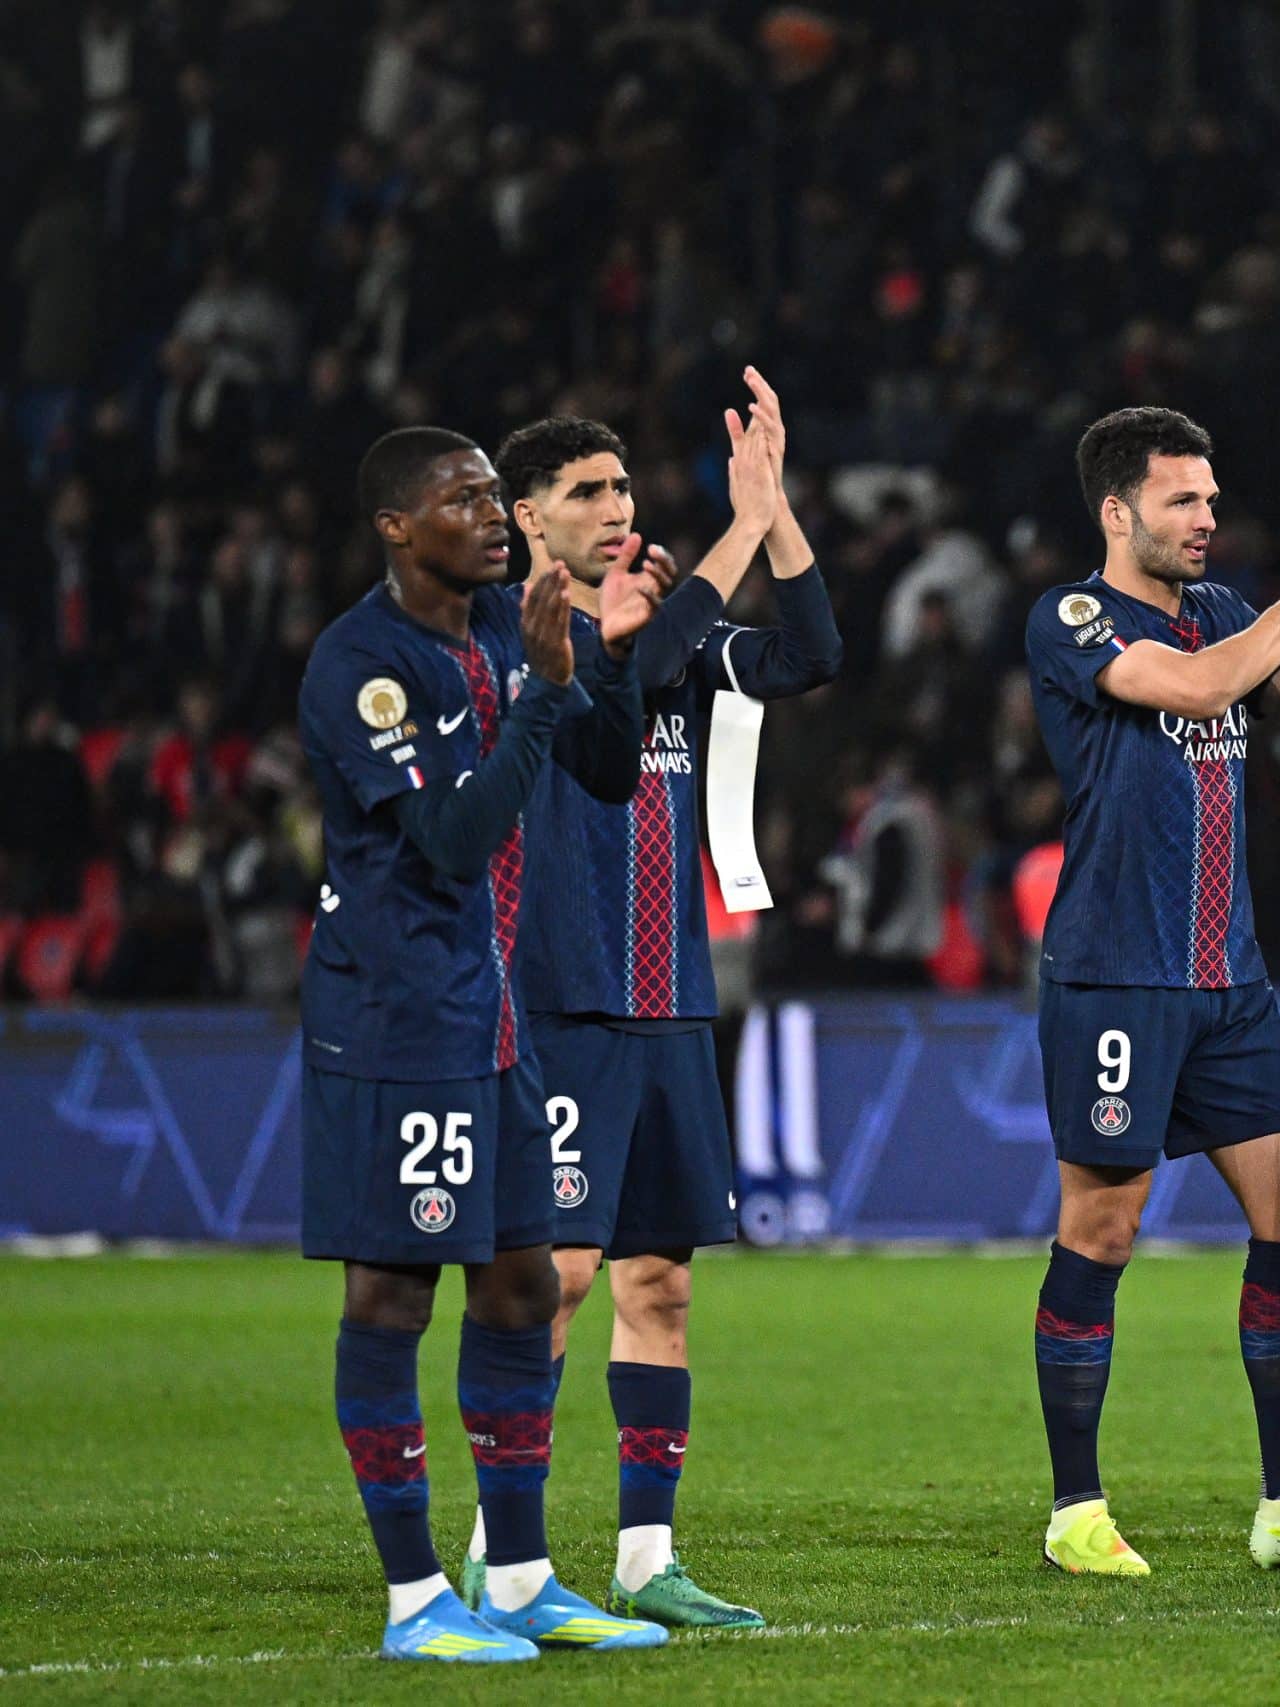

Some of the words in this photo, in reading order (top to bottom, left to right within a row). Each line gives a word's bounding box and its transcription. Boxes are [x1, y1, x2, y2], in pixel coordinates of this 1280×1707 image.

[640, 751, 692, 775] RWAYS
[1183, 738, 1248, 761] AIRWAY
[1097, 1029, 1131, 1094] 9
[1098, 1097, 1125, 1110] PARIS
[399, 1110, 473, 1186] 25
[544, 1095, 582, 1164] 2
